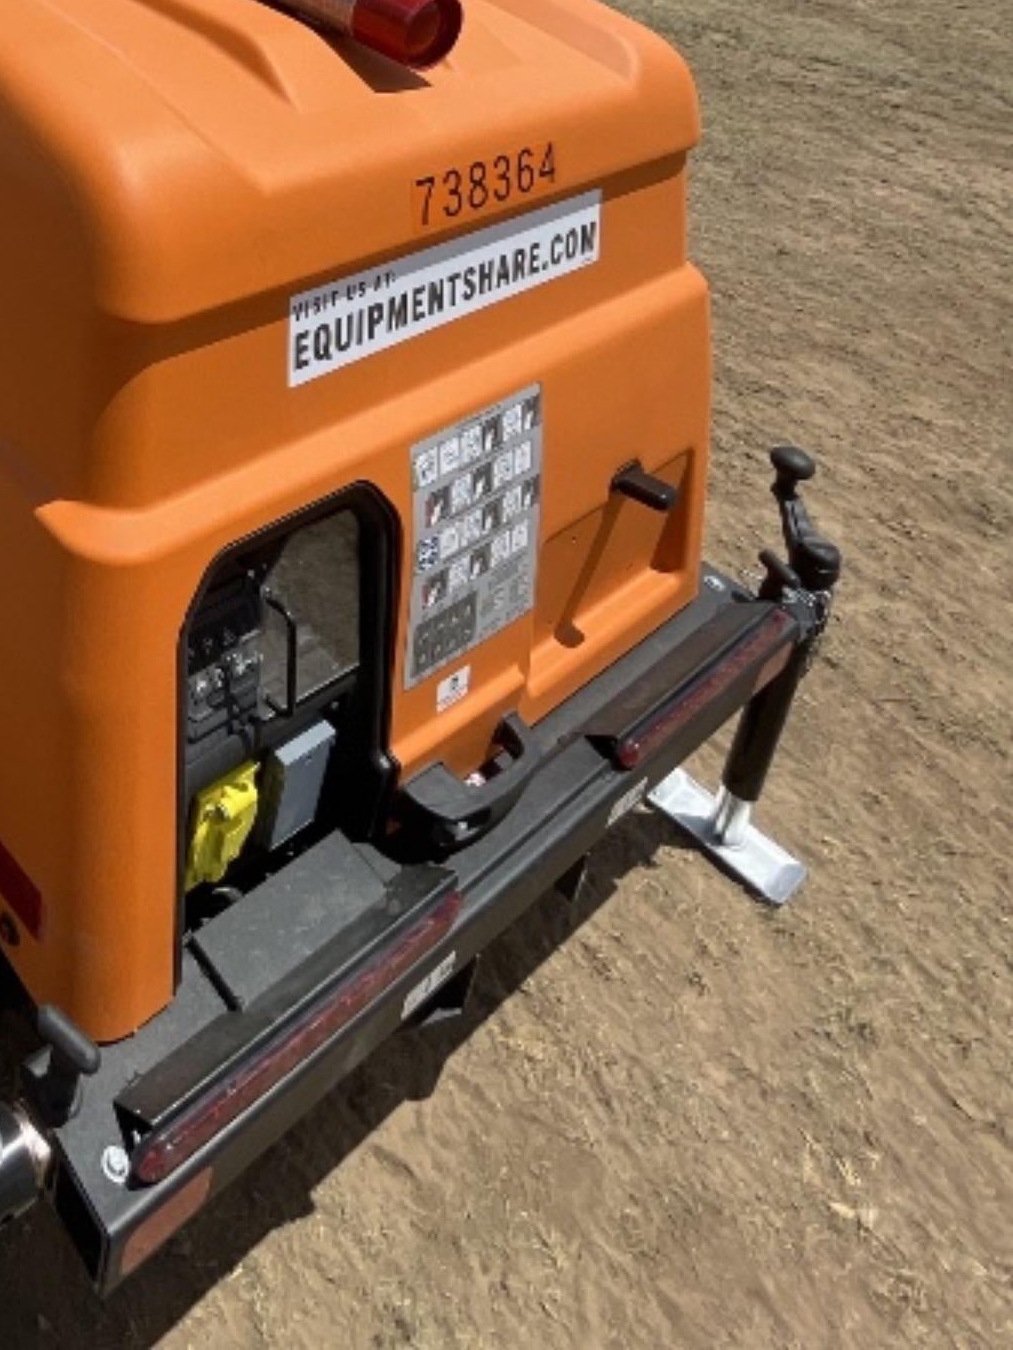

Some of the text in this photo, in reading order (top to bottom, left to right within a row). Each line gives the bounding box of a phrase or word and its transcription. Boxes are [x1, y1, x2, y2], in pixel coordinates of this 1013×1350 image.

[415, 142, 555, 226] 738364
[292, 290, 339, 322] VISIT
[346, 281, 366, 301] US
[293, 221, 597, 371] EQUIPMENTSHARE.COM
